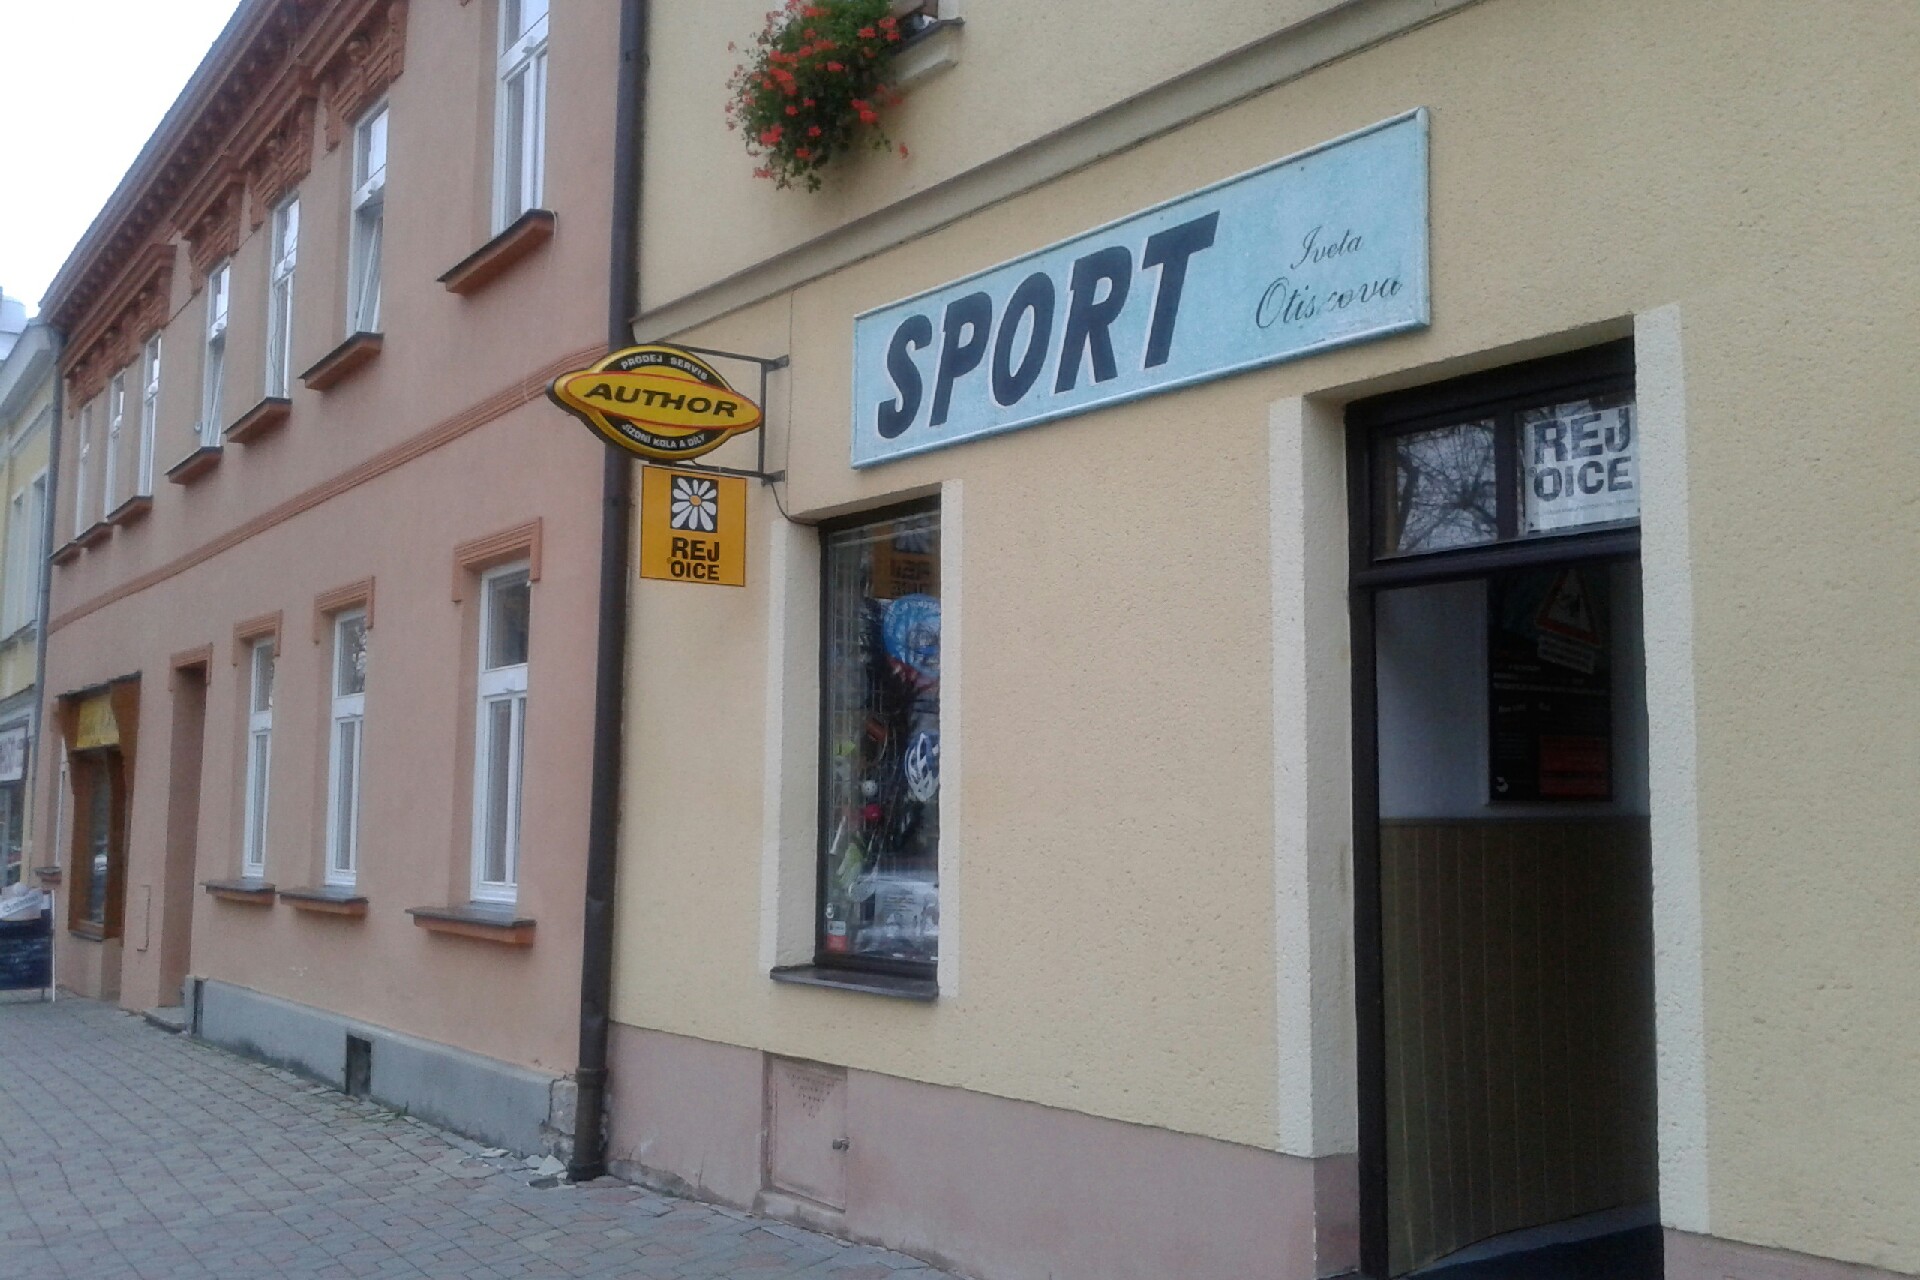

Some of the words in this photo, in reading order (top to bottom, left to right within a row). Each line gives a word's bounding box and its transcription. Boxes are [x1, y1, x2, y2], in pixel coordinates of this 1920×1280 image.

[1290, 225, 1362, 269] Iveta
[877, 210, 1220, 438] SPORT
[621, 354, 663, 370] PRODEJ
[670, 357, 708, 381] SERVIS
[584, 383, 738, 418] AUTHOR
[653, 438, 677, 448] KOLA
[1534, 407, 1630, 465] REJ
[1534, 456, 1633, 502] OICE
[671, 537, 720, 562] REJ
[671, 561, 720, 581] OICE
